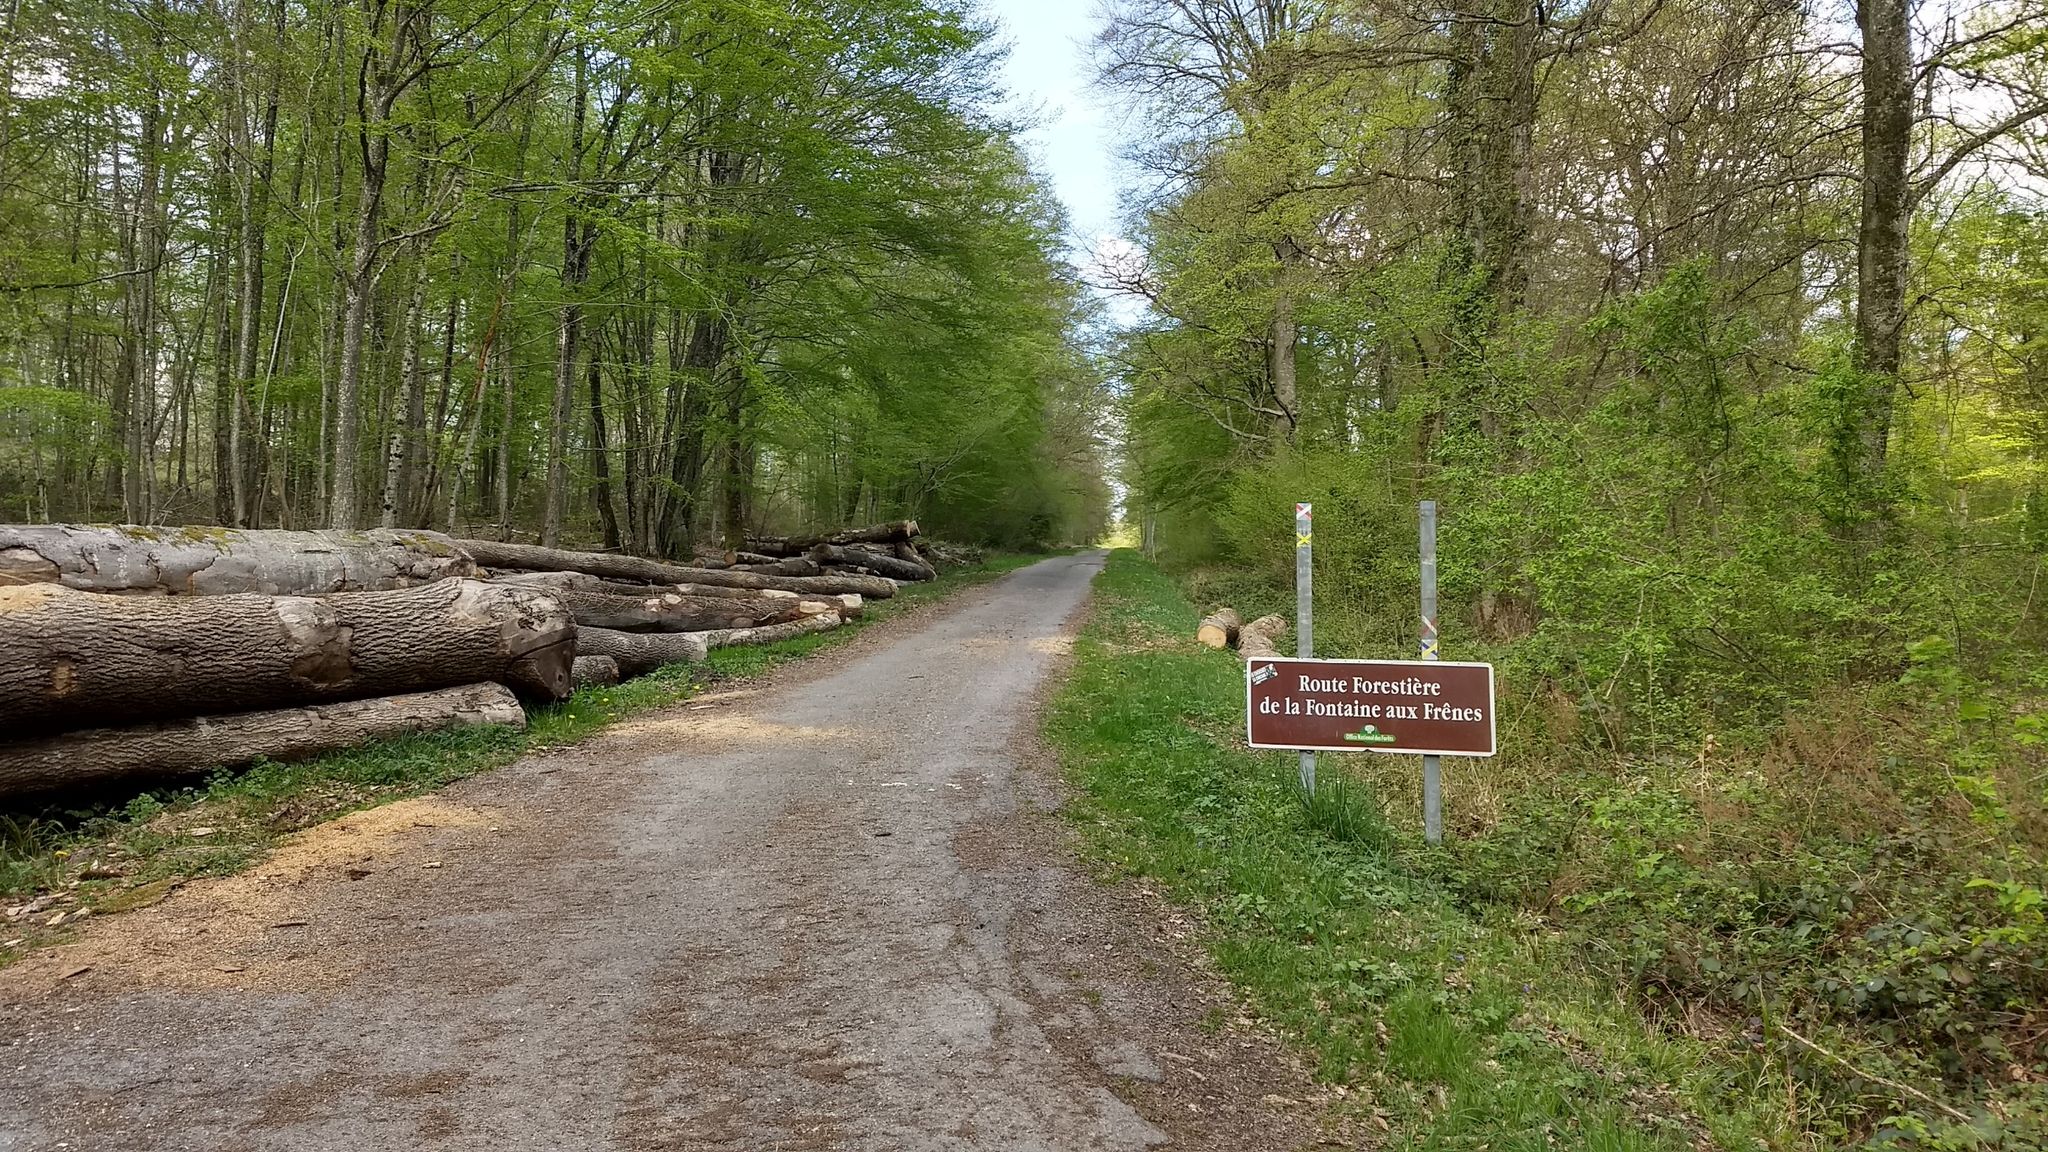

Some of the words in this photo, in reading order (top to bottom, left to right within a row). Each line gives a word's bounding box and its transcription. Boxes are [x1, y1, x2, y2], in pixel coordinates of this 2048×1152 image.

[1299, 675, 1347, 693] Route
[1352, 676, 1441, 696] Forestière
[1259, 696, 1280, 714] de
[1285, 697, 1300, 715] la
[1305, 699, 1381, 718] Fontaine
[1386, 705, 1418, 720] aux
[1423, 702, 1482, 721] Frênes
